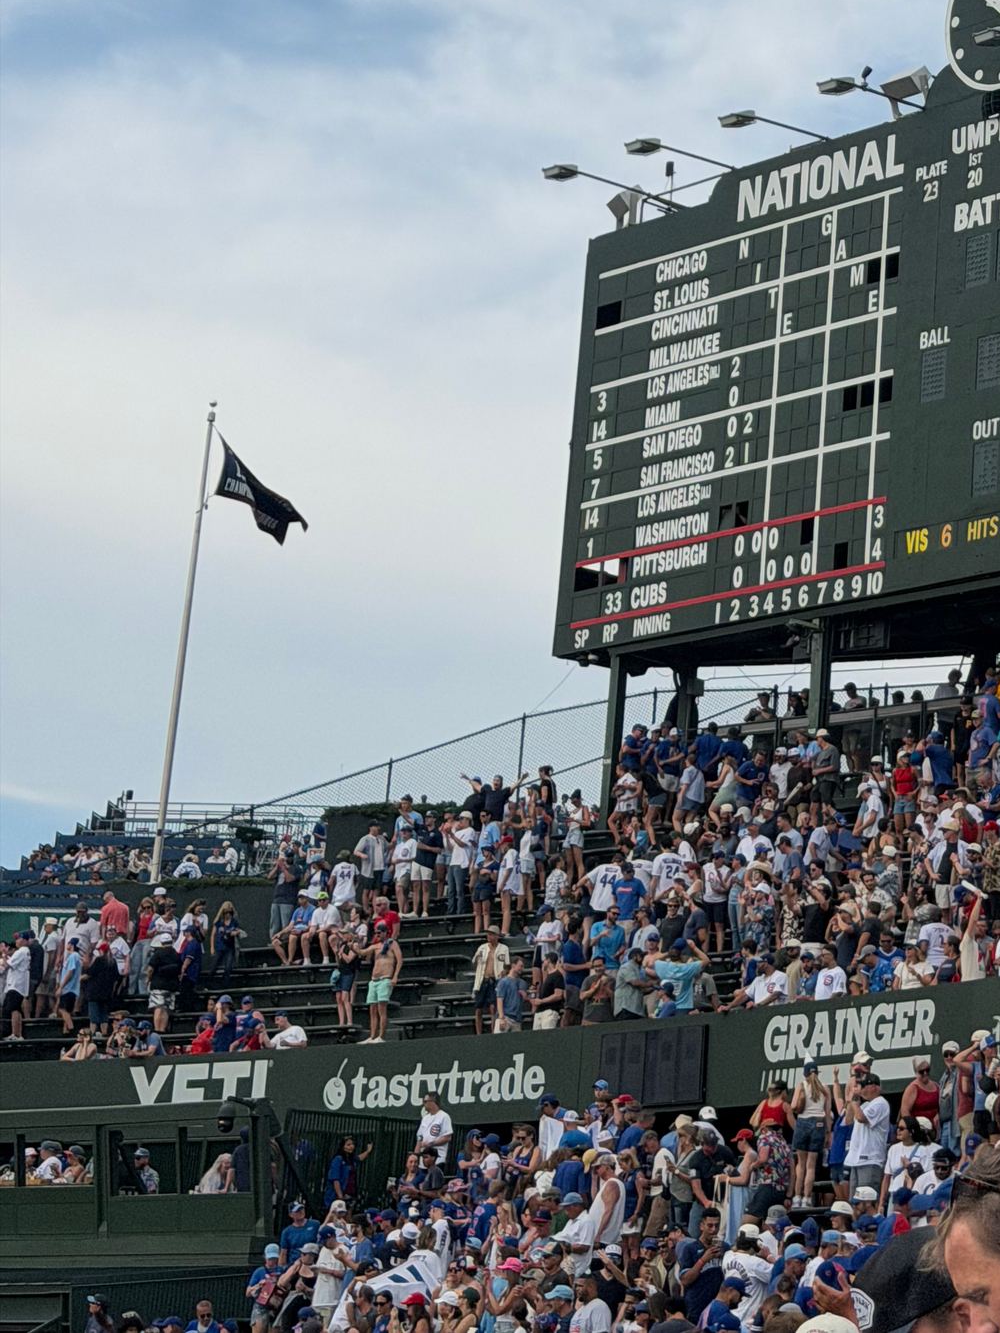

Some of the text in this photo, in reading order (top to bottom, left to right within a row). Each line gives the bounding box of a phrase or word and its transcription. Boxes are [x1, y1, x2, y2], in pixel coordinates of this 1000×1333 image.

[737, 134, 905, 223] NATIONAL
[915, 160, 948, 182] PLATE
[923, 181, 939, 203] 23
[967, 167, 983, 189] 20
[655, 250, 708, 284] CHICAGO
[653, 277, 710, 312] ST. LOUIS
[650, 304, 719, 341] CINCINNATI
[920, 326, 950, 350] BALL
[649, 332, 721, 370] MILWAUKEE
[596, 391, 607, 412] 3
[647, 378, 665, 400] LOS
[666, 368, 710, 395] ANGELES
[730, 356, 741, 378] 2
[592, 386, 739, 442] 14 MIAMI 0
[973, 417, 1000, 440] OUT
[593, 413, 753, 470] 5 SAN DIEGO 0 2
[591, 478, 600, 499] 7
[640, 466, 659, 488] SAN
[661, 451, 715, 484] FRANCISCO
[724, 446, 735, 468] 2
[584, 509, 599, 530] 14
[637, 496, 656, 518] LOS
[657, 483, 700, 513] ANGELES
[586, 512, 709, 558] 1 WASHINGTON
[632, 505, 884, 578] PITTSBURGH 0 0 0 3
[906, 528, 928, 554] VIS
[940, 524, 952, 548] 6
[967, 516, 999, 541] HITS
[605, 538, 882, 615] 33 CUBS 0 0 0 0 4
[574, 629, 589, 649] SP
[602, 623, 618, 644] RP
[632, 613, 671, 637] INNING
[729, 599, 740, 621] 2
[748, 595, 759, 618] 3
[763, 592, 774, 614] 4
[781, 588, 791, 611] 5
[798, 584, 809, 608] 6
[817, 581, 828, 604] 7
[833, 578, 844, 602] 8
[851, 575, 862, 598] 9
[867, 571, 883, 595] 10
[600, 873, 618, 888] 44
[764, 999, 936, 1063] GRAINGER
[351, 1053, 546, 1111] tastytrade
